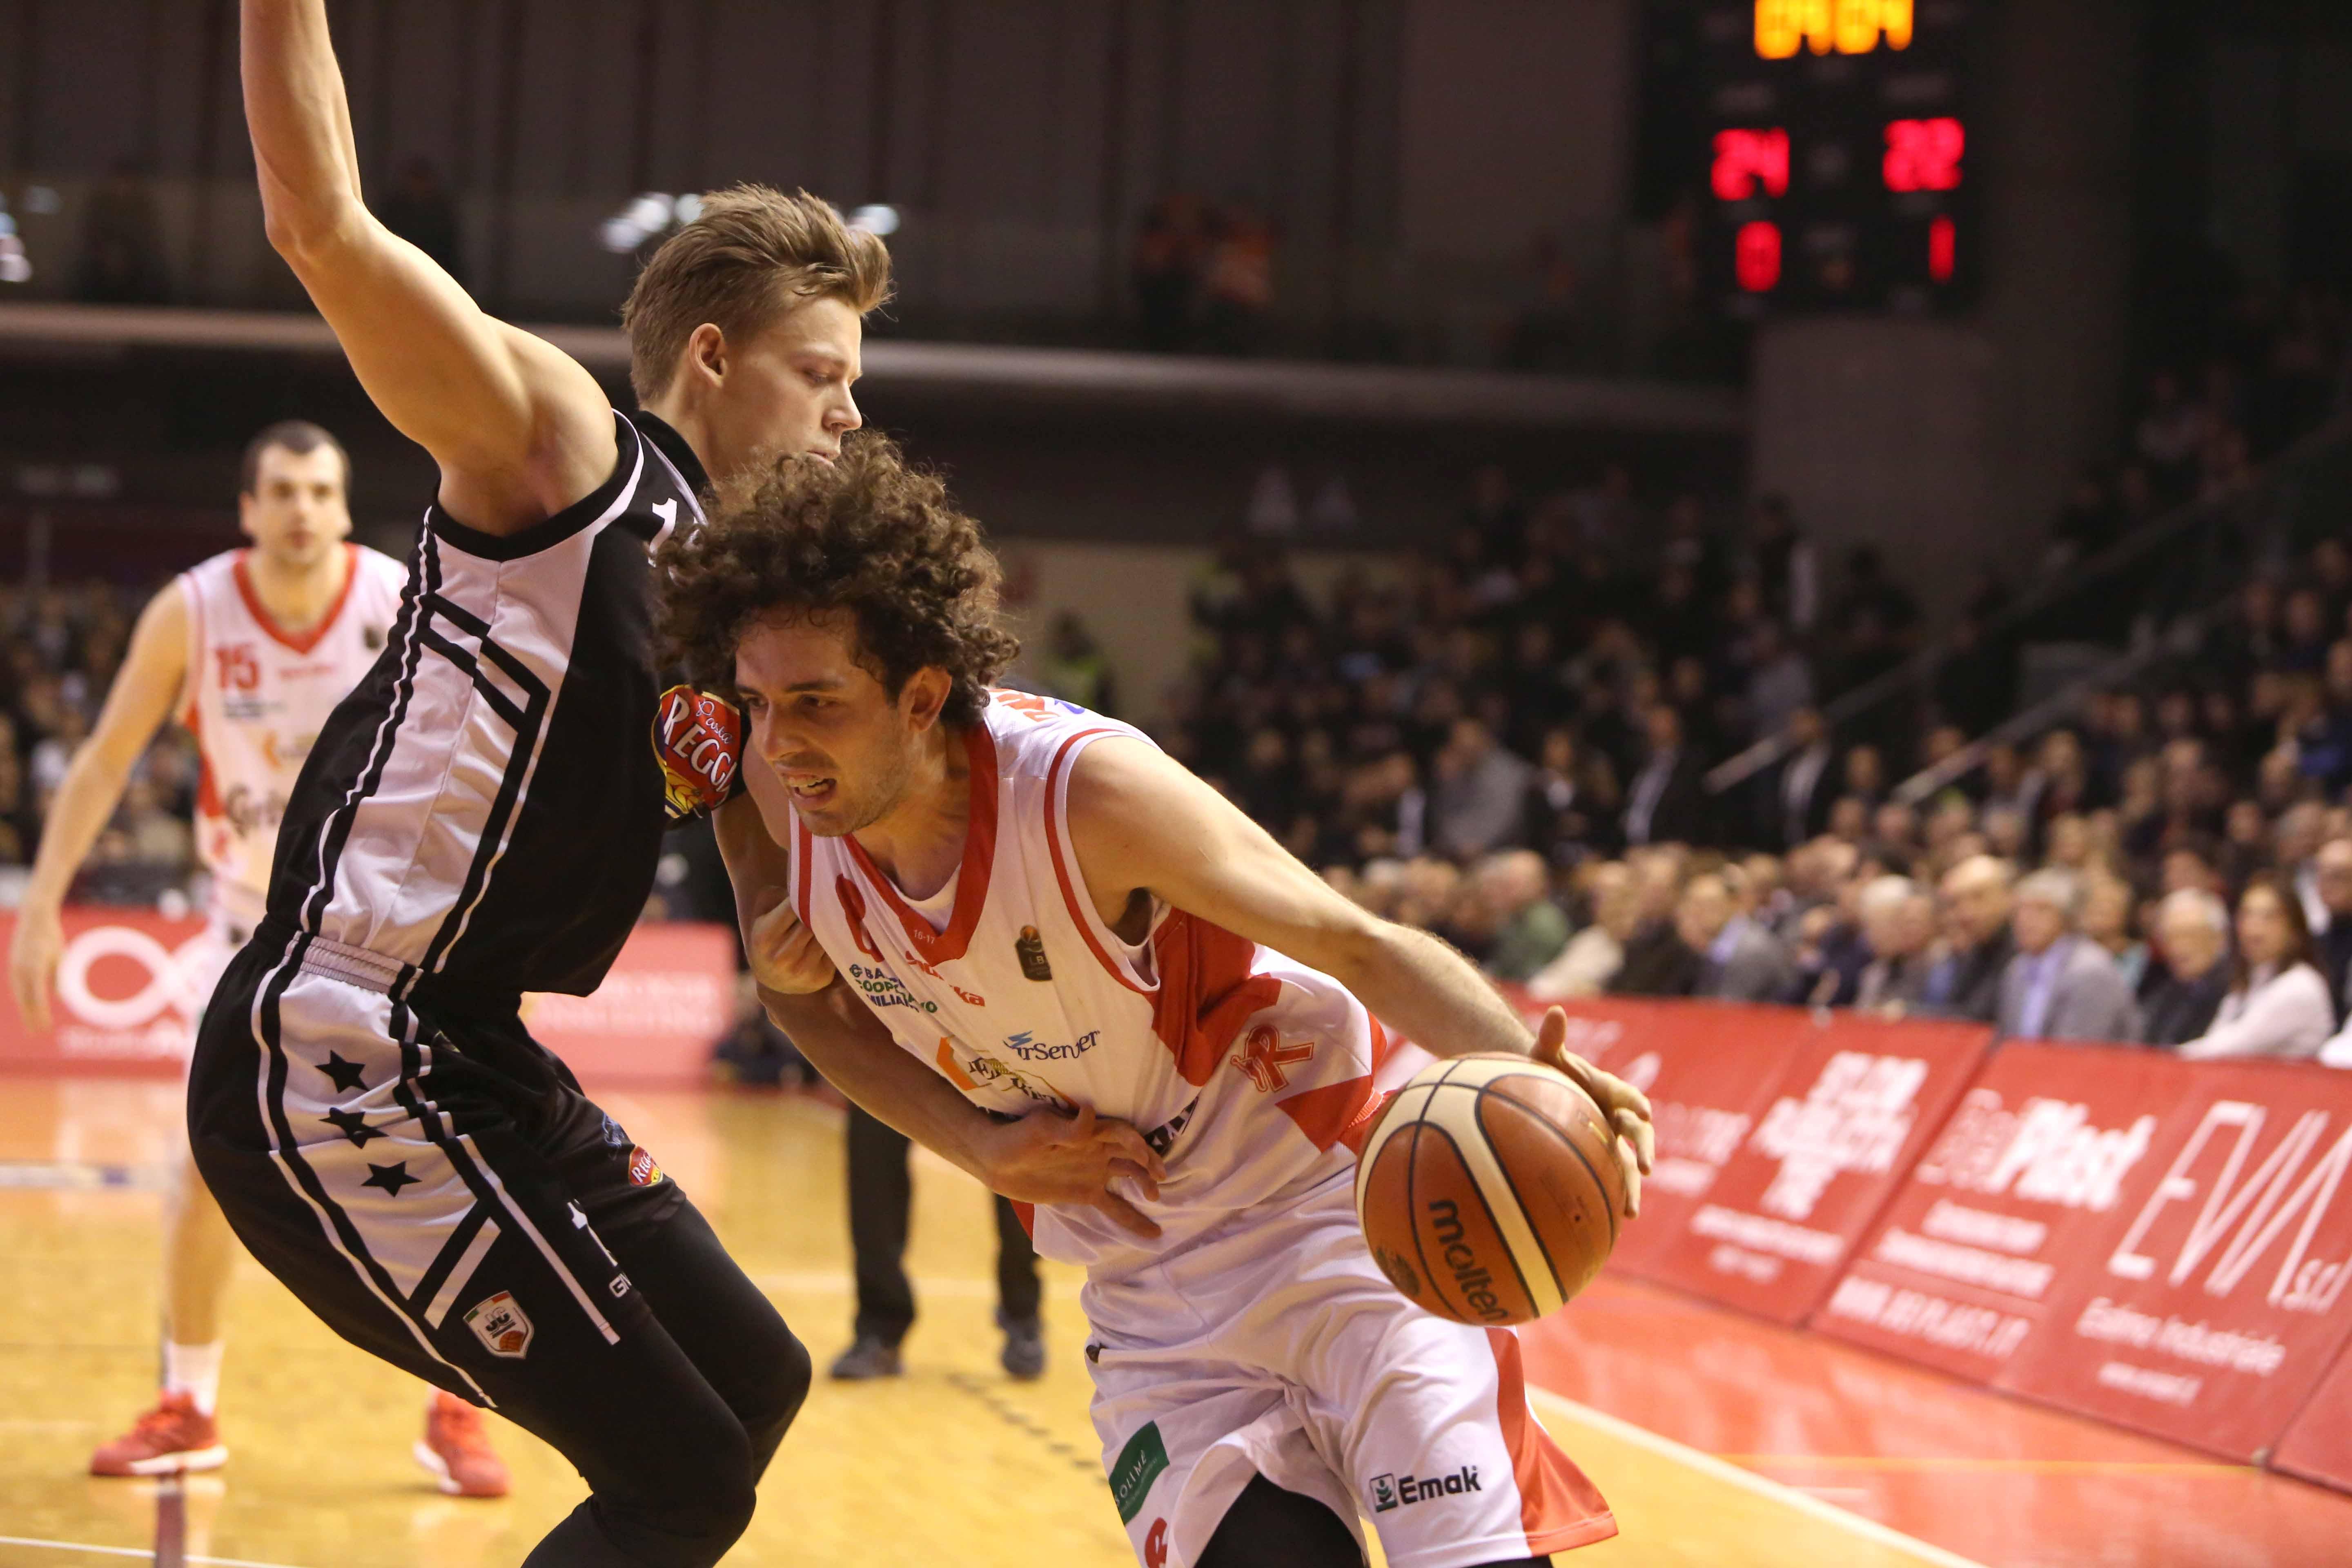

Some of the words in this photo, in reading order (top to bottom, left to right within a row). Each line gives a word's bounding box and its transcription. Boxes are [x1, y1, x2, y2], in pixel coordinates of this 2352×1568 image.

[215, 644, 261, 691] 15
[695, 698, 733, 744] Pasta
[914, 929, 935, 944] 16-17
[1429, 1199, 1509, 1321] molten
[1398, 1465, 1482, 1505] Emak
